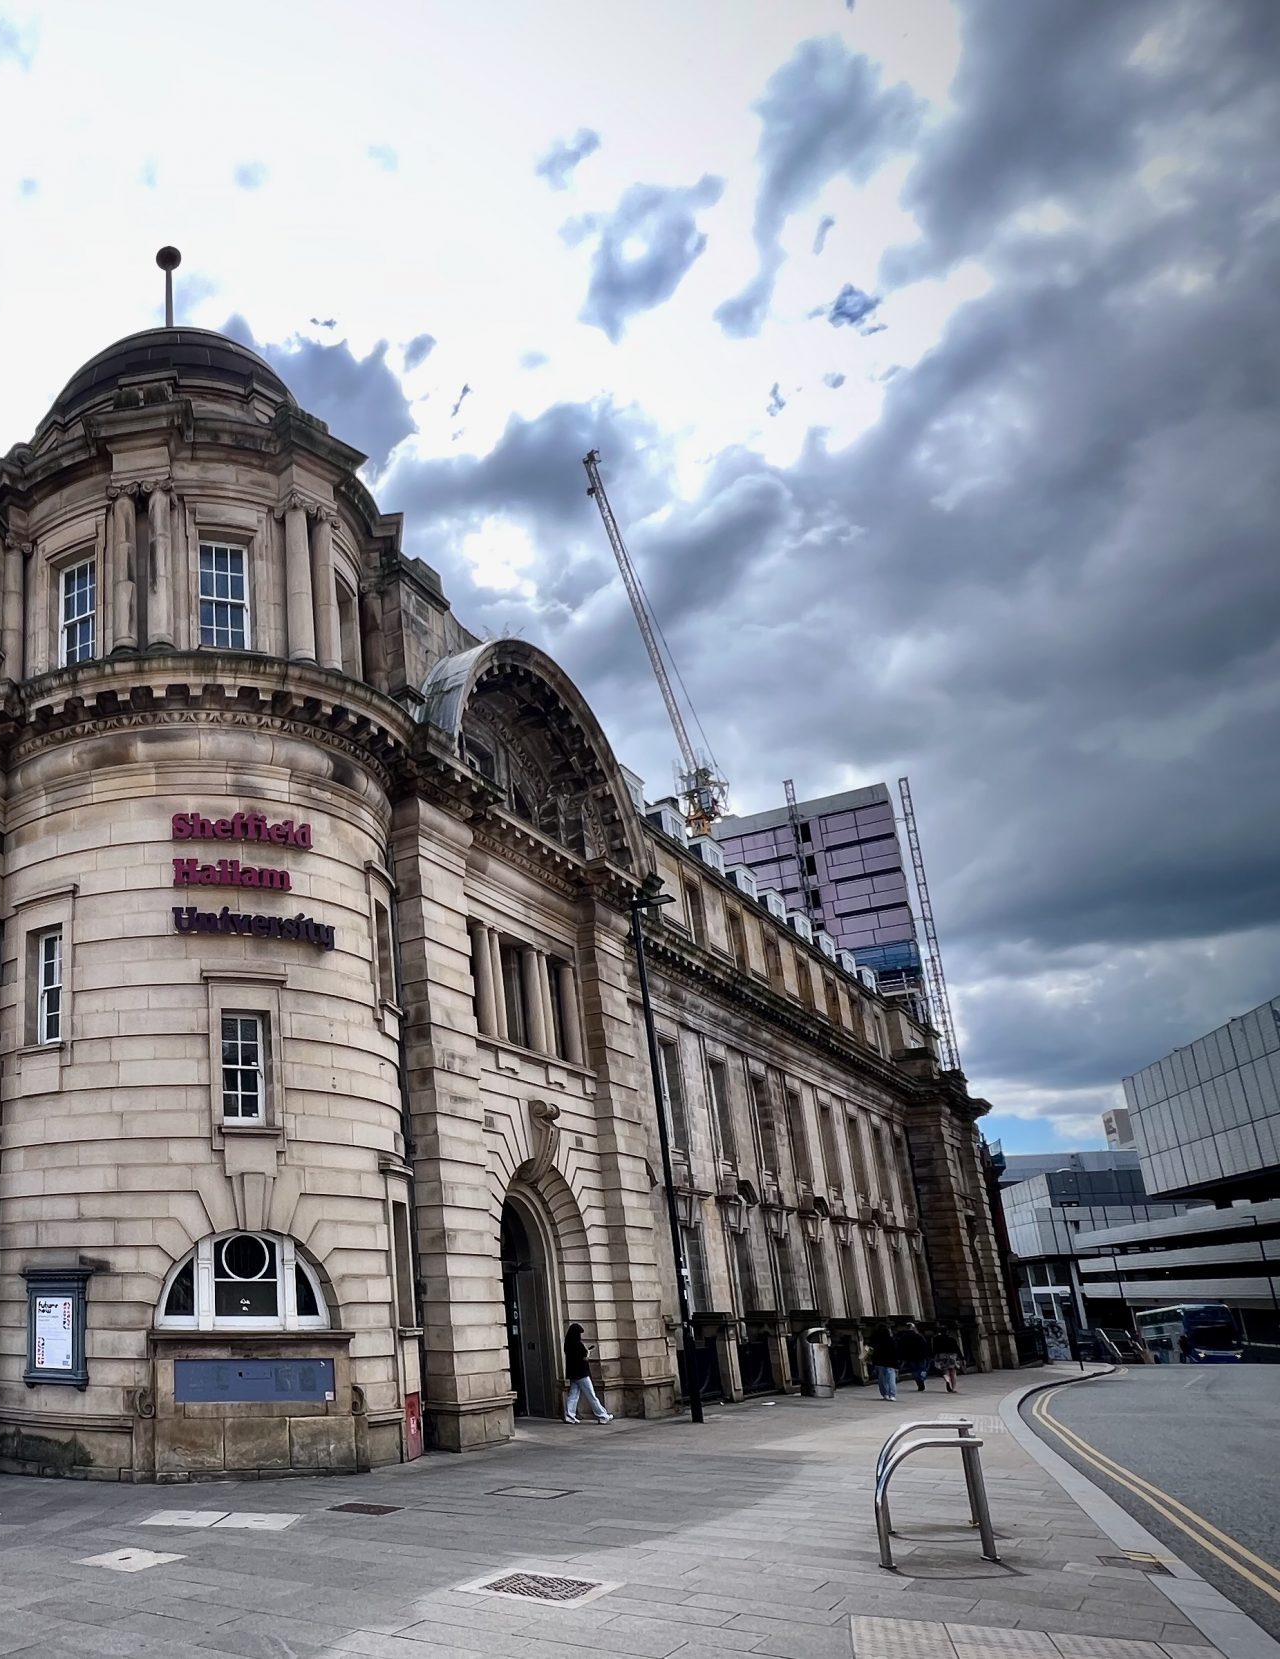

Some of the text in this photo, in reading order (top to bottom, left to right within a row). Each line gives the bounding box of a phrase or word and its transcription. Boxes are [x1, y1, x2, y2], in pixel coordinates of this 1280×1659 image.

[172, 812, 313, 850] Sheffield
[173, 858, 292, 891] Hallam
[172, 906, 335, 951] University
